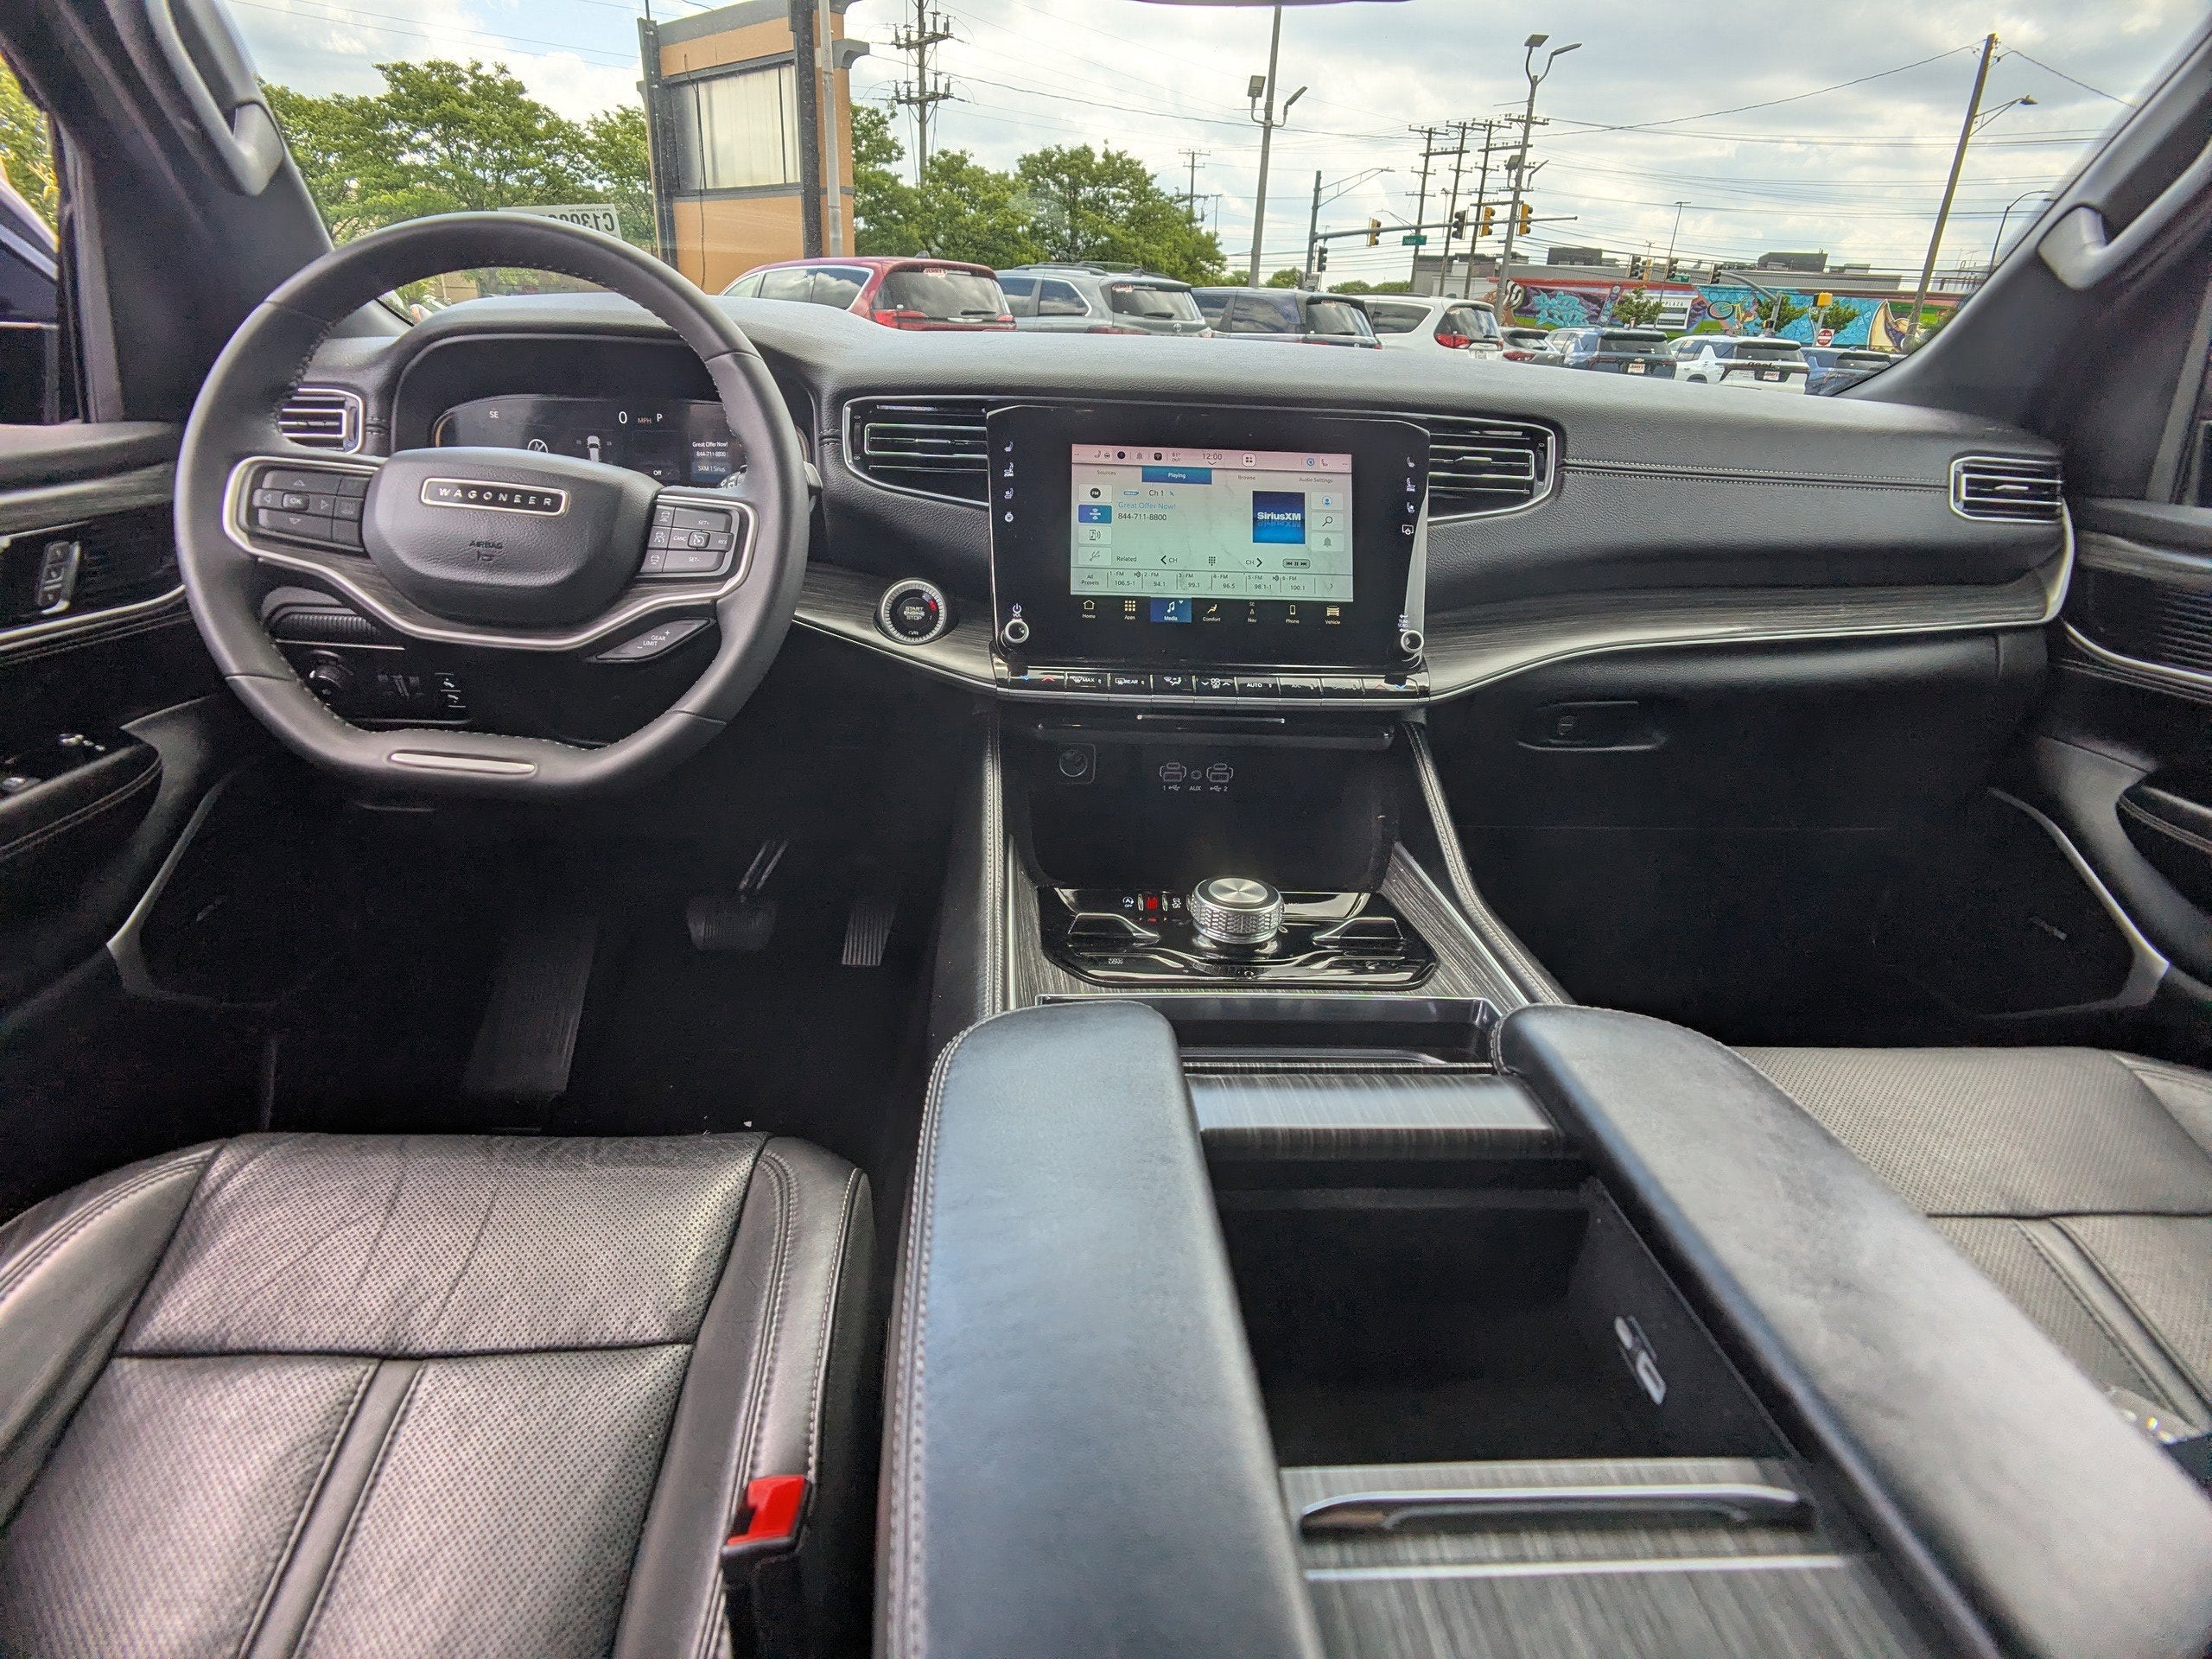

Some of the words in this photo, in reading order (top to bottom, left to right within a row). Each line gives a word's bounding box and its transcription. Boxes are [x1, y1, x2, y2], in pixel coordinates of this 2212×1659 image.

[618, 410, 628, 424] 0
[656, 413, 663, 422] P
[439, 486, 553, 507] WAGONEER
[1256, 512, 1301, 521] SiriusXM
[469, 540, 504, 550] AIRBAG
